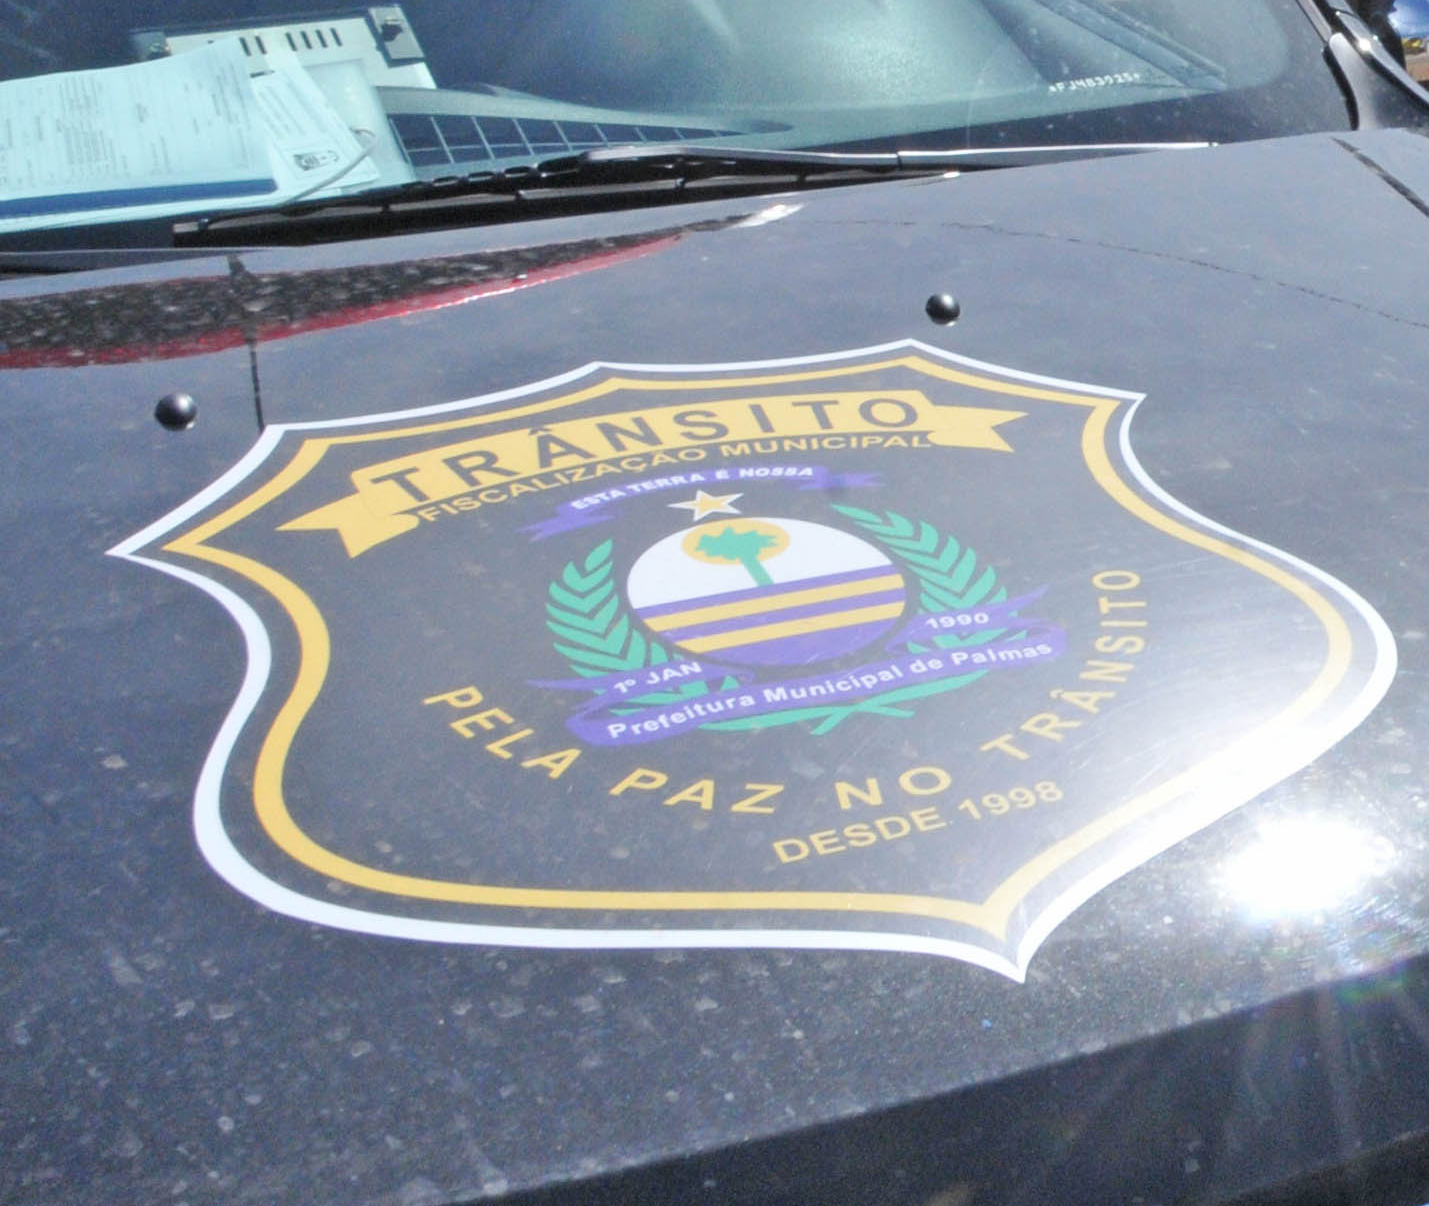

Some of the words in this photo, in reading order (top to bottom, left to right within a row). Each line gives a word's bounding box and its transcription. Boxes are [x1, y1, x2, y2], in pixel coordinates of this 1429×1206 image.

[369, 397, 920, 504] TRÂNSITO
[417, 447, 707, 523] FISCALIZAÇÃO
[720, 435, 932, 457] MUNICIPAL
[571, 488, 626, 511] ESTA
[627, 473, 704, 495] TERRA
[715, 467, 729, 480] É
[739, 466, 813, 478] NOSSA
[925, 613, 990, 630] 1990
[423, 685, 582, 781] PELA
[609, 767, 785, 815] PAZ
[836, 766, 953, 810] NO
[980, 569, 1147, 762] TRÂNSITO
[608, 693, 755, 739] Prefeitura
[763, 665, 903, 704] Municipal
[910, 654, 943, 675] de
[951, 638, 1053, 670] Palmas
[645, 662, 702, 685] JAN
[772, 806, 947, 864] DESDE
[957, 780, 1064, 821] 1998
